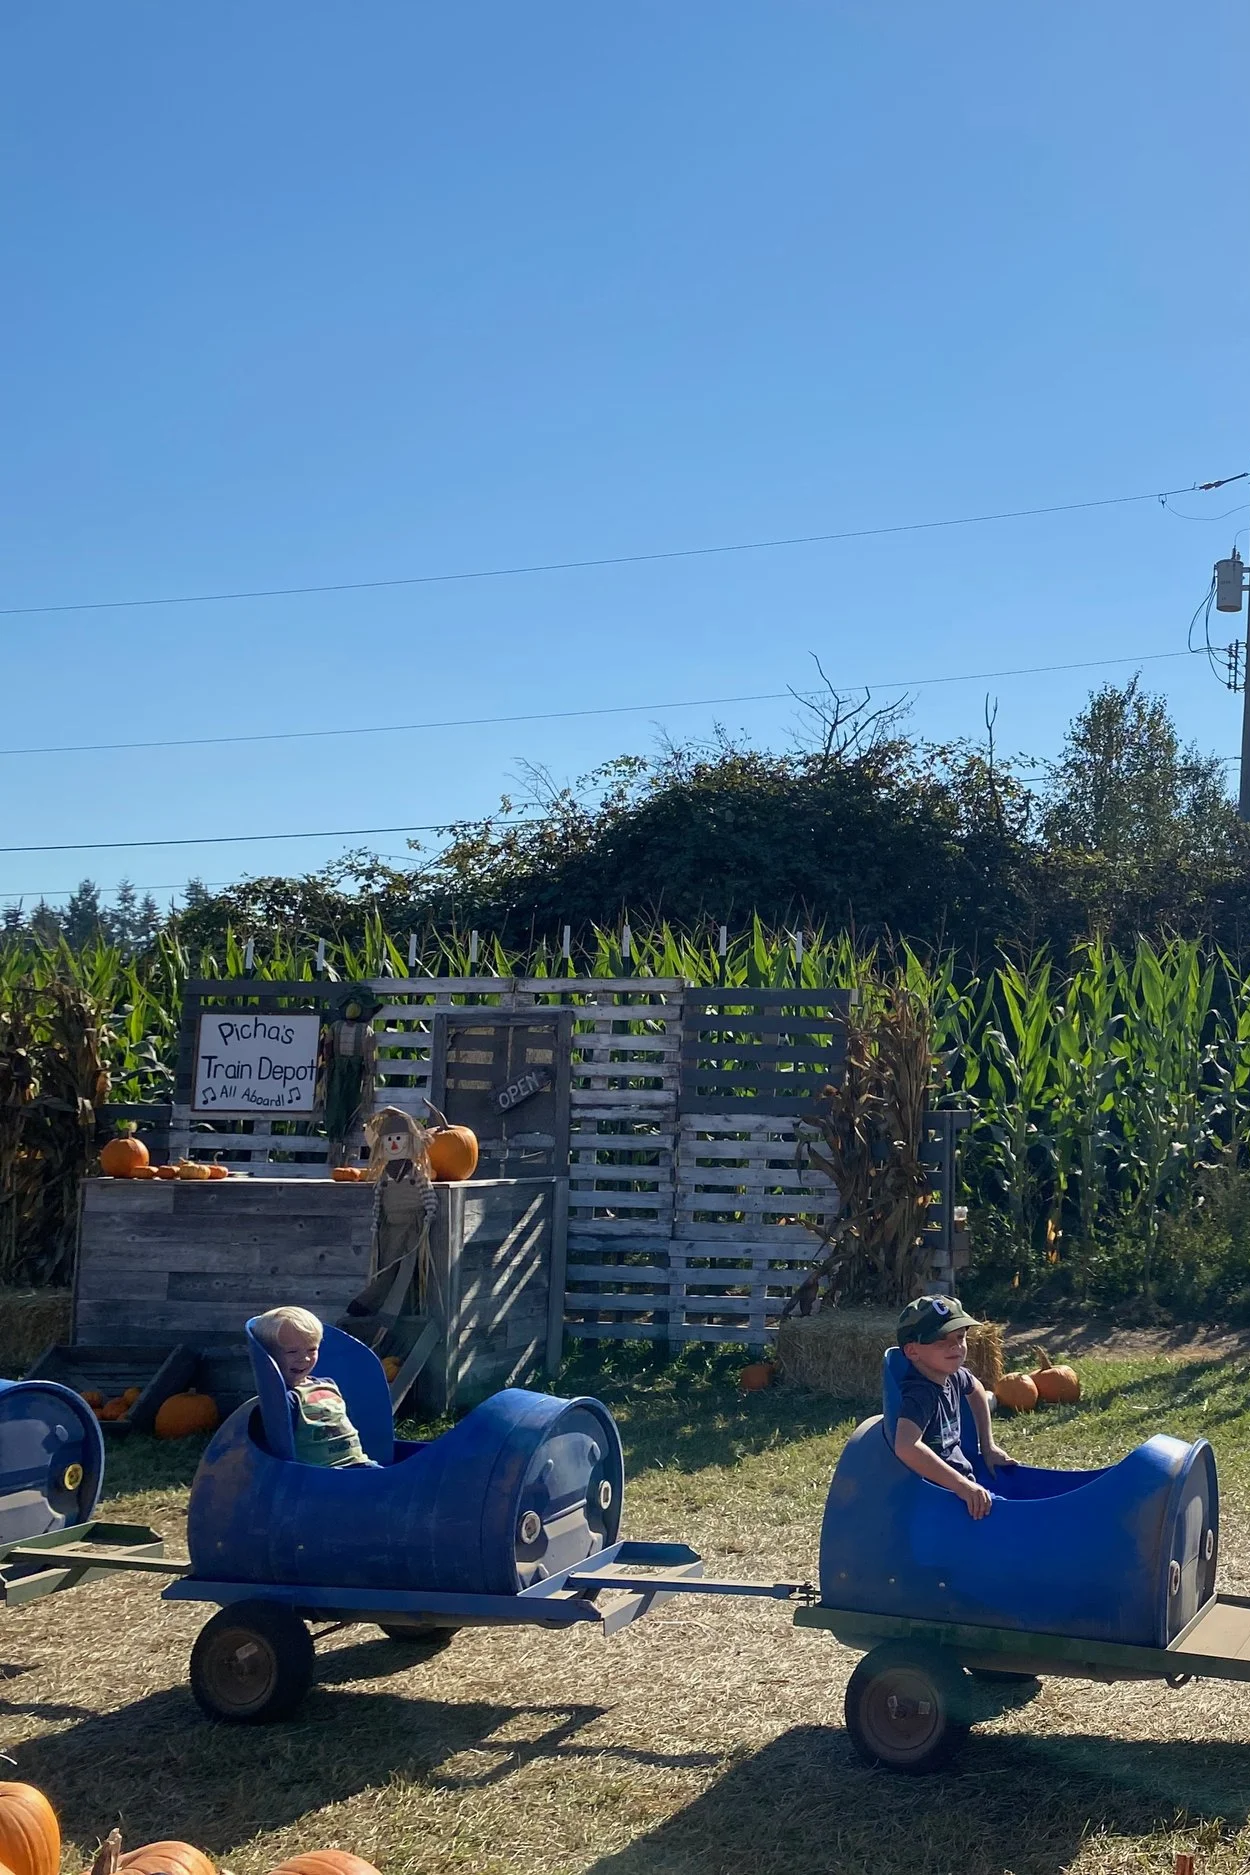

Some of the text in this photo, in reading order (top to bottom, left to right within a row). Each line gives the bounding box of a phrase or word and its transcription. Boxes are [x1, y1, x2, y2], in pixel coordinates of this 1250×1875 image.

[218, 1017, 294, 1045] Picha's
[201, 1056, 317, 1088] Train Depot
[220, 1085, 237, 1098] All
[499, 1072, 539, 1107] OPEN
[932, 1299, 949, 1315] C
